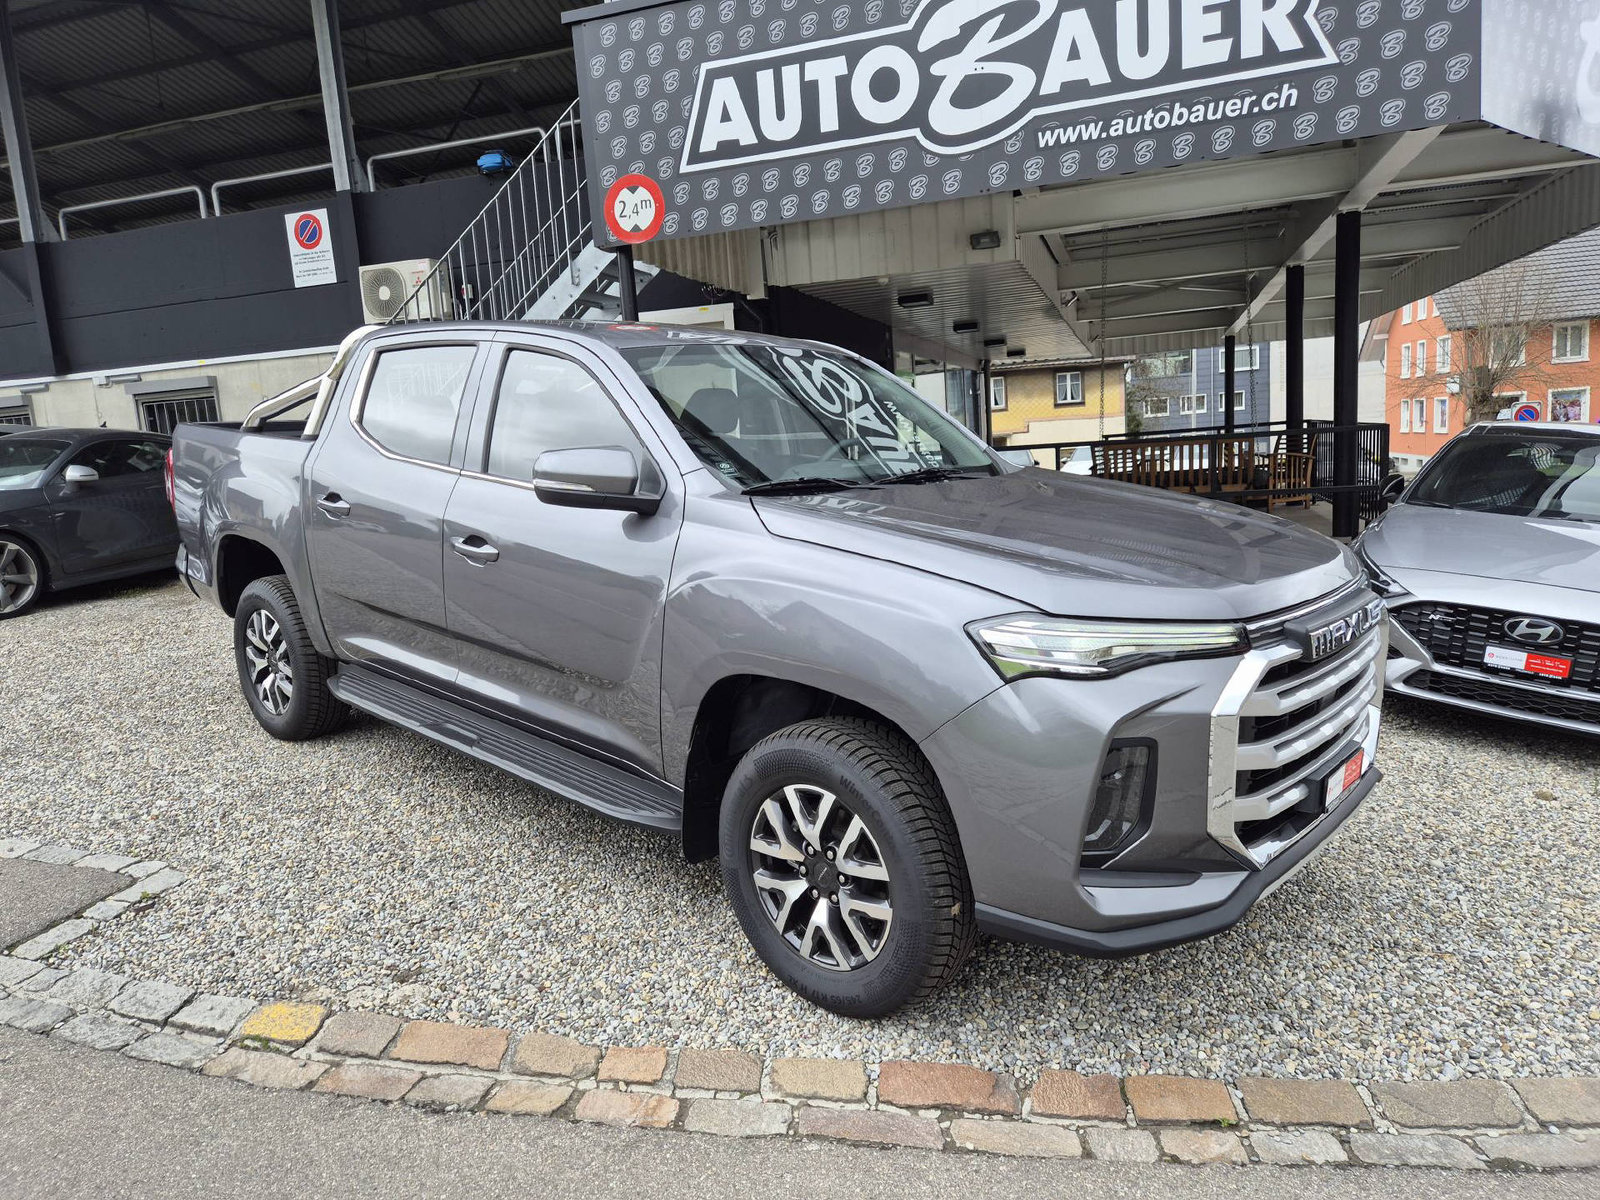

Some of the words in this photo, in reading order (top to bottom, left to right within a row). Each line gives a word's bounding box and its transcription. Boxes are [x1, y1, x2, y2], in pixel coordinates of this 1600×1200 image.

[699, 45, 920, 153] AUTO
[915, 0, 1304, 136] BAUER
[1037, 83, 1299, 148] www.autobauer.ch
[1308, 598, 1382, 659] MAXUS
